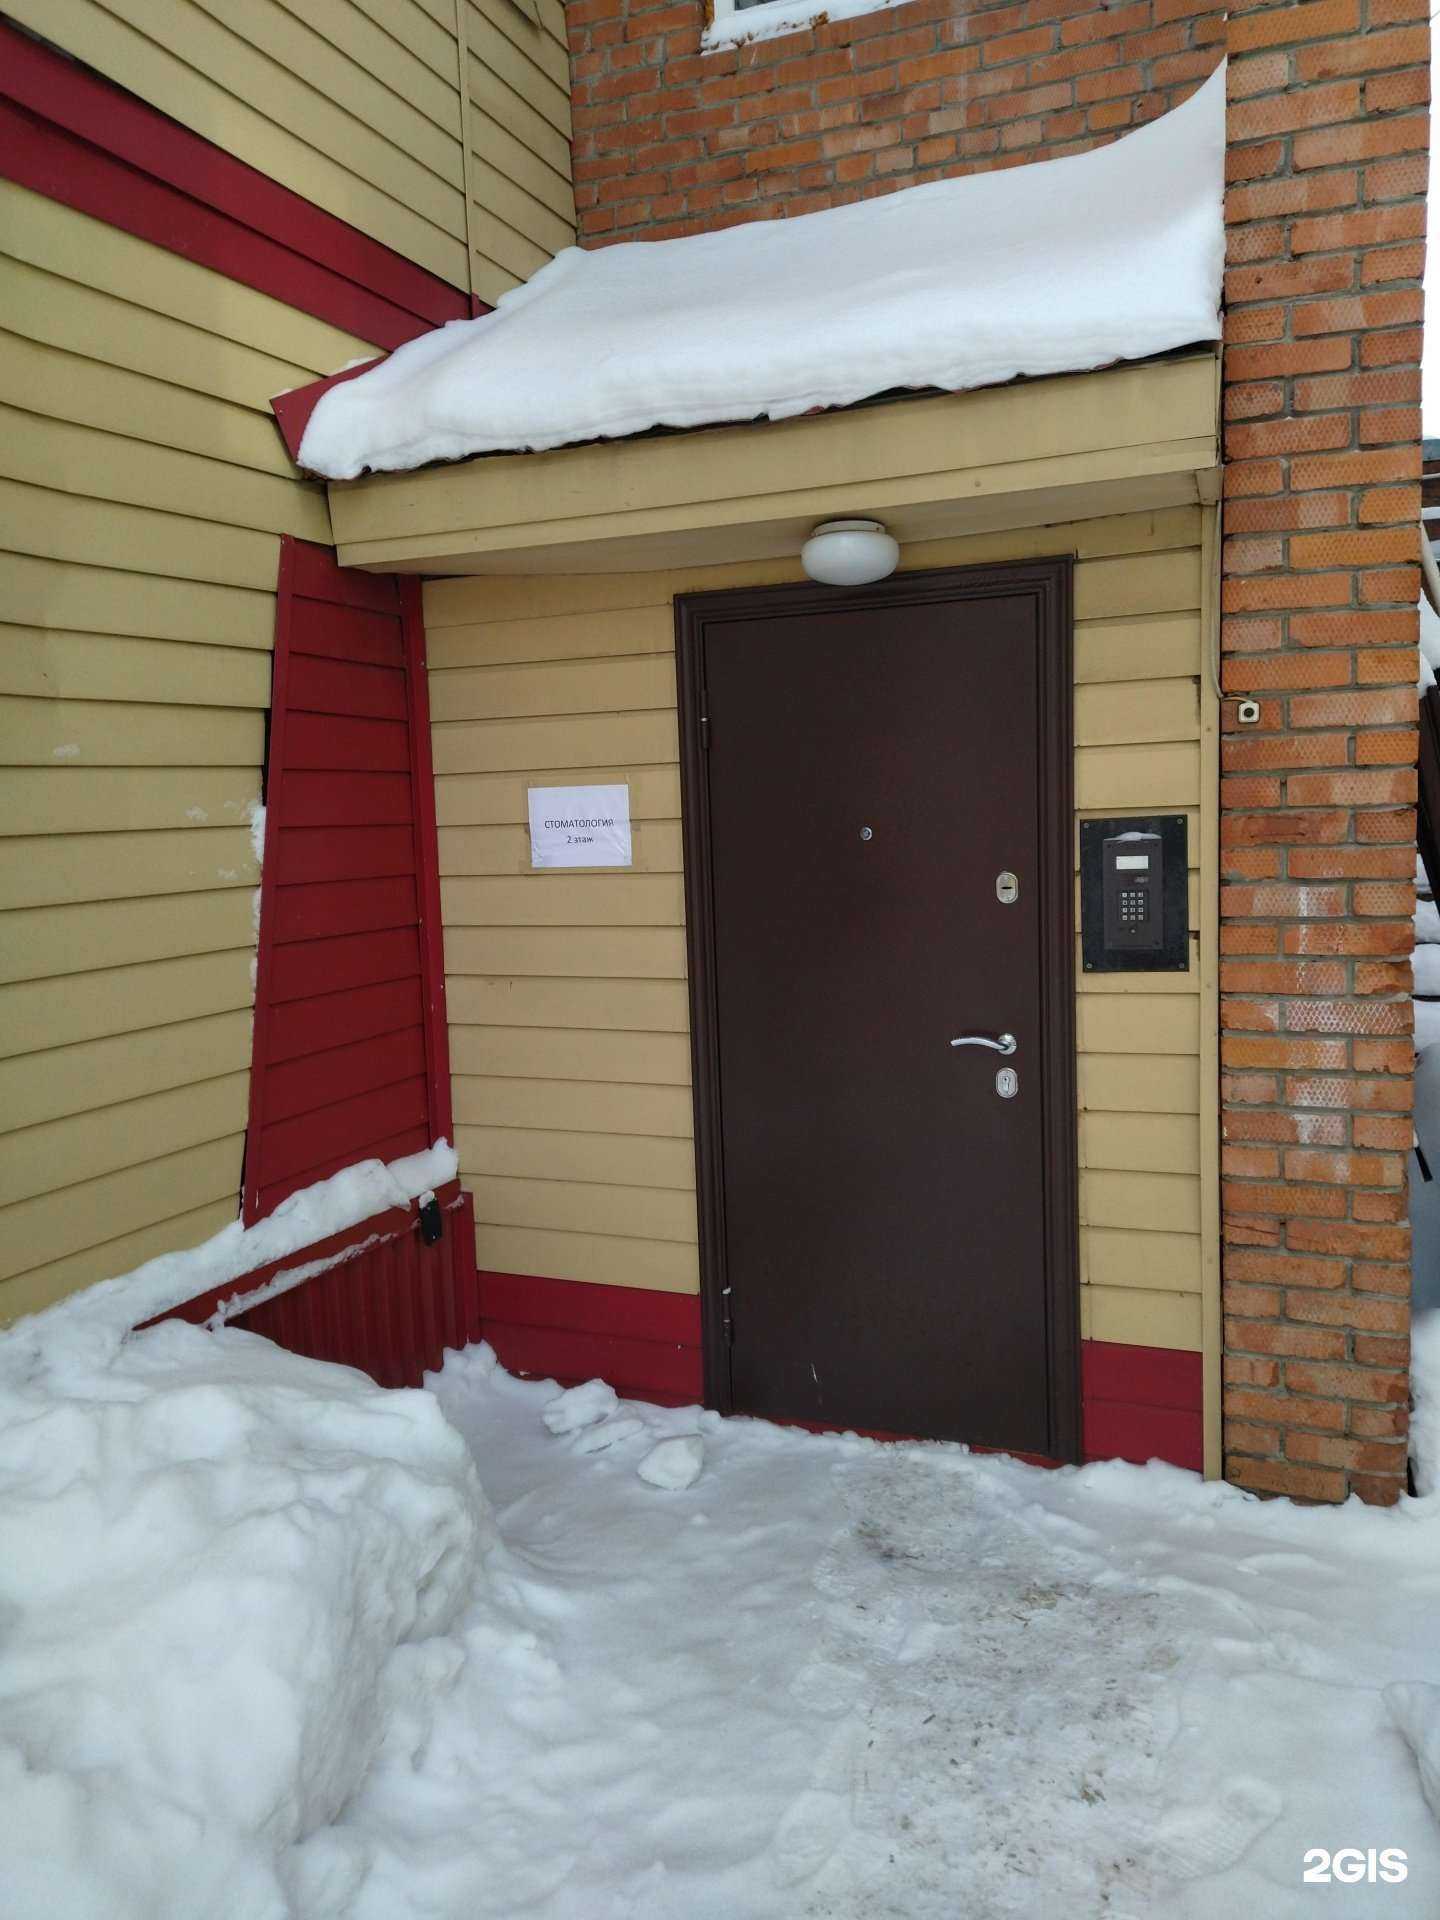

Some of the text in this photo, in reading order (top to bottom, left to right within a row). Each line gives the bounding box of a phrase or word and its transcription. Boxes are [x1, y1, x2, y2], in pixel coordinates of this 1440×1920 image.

[544, 819, 614, 829] СТОМАТОЛОГИЯ
[567, 835, 594, 844] 2 этаж
